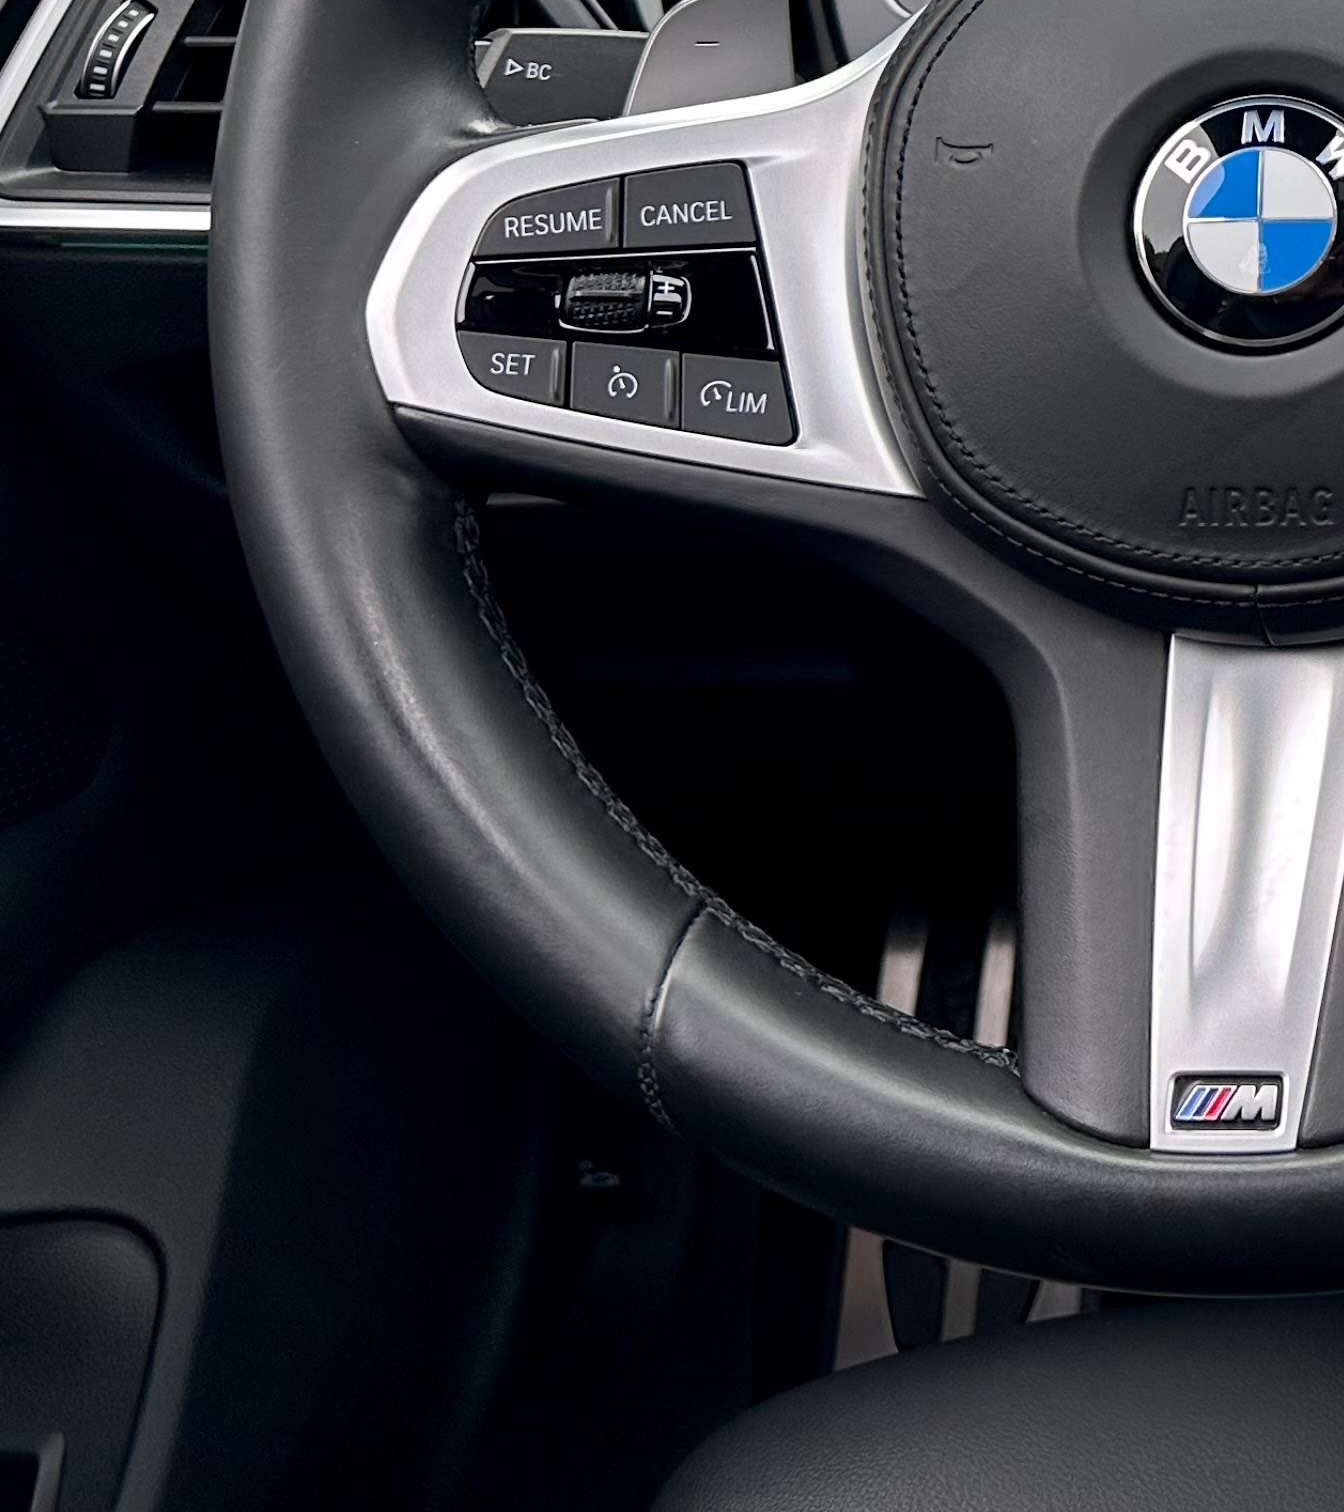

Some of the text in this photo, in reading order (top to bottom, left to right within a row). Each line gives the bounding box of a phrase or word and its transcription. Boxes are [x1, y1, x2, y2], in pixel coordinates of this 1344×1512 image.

[526, 62, 552, 81] BC
[504, 208, 602, 239] RESUME
[640, 200, 732, 228] CANCEL
[490, 352, 535, 376] SET
[725, 390, 768, 414] LIM
[1178, 486, 1337, 528] AIRBAG
